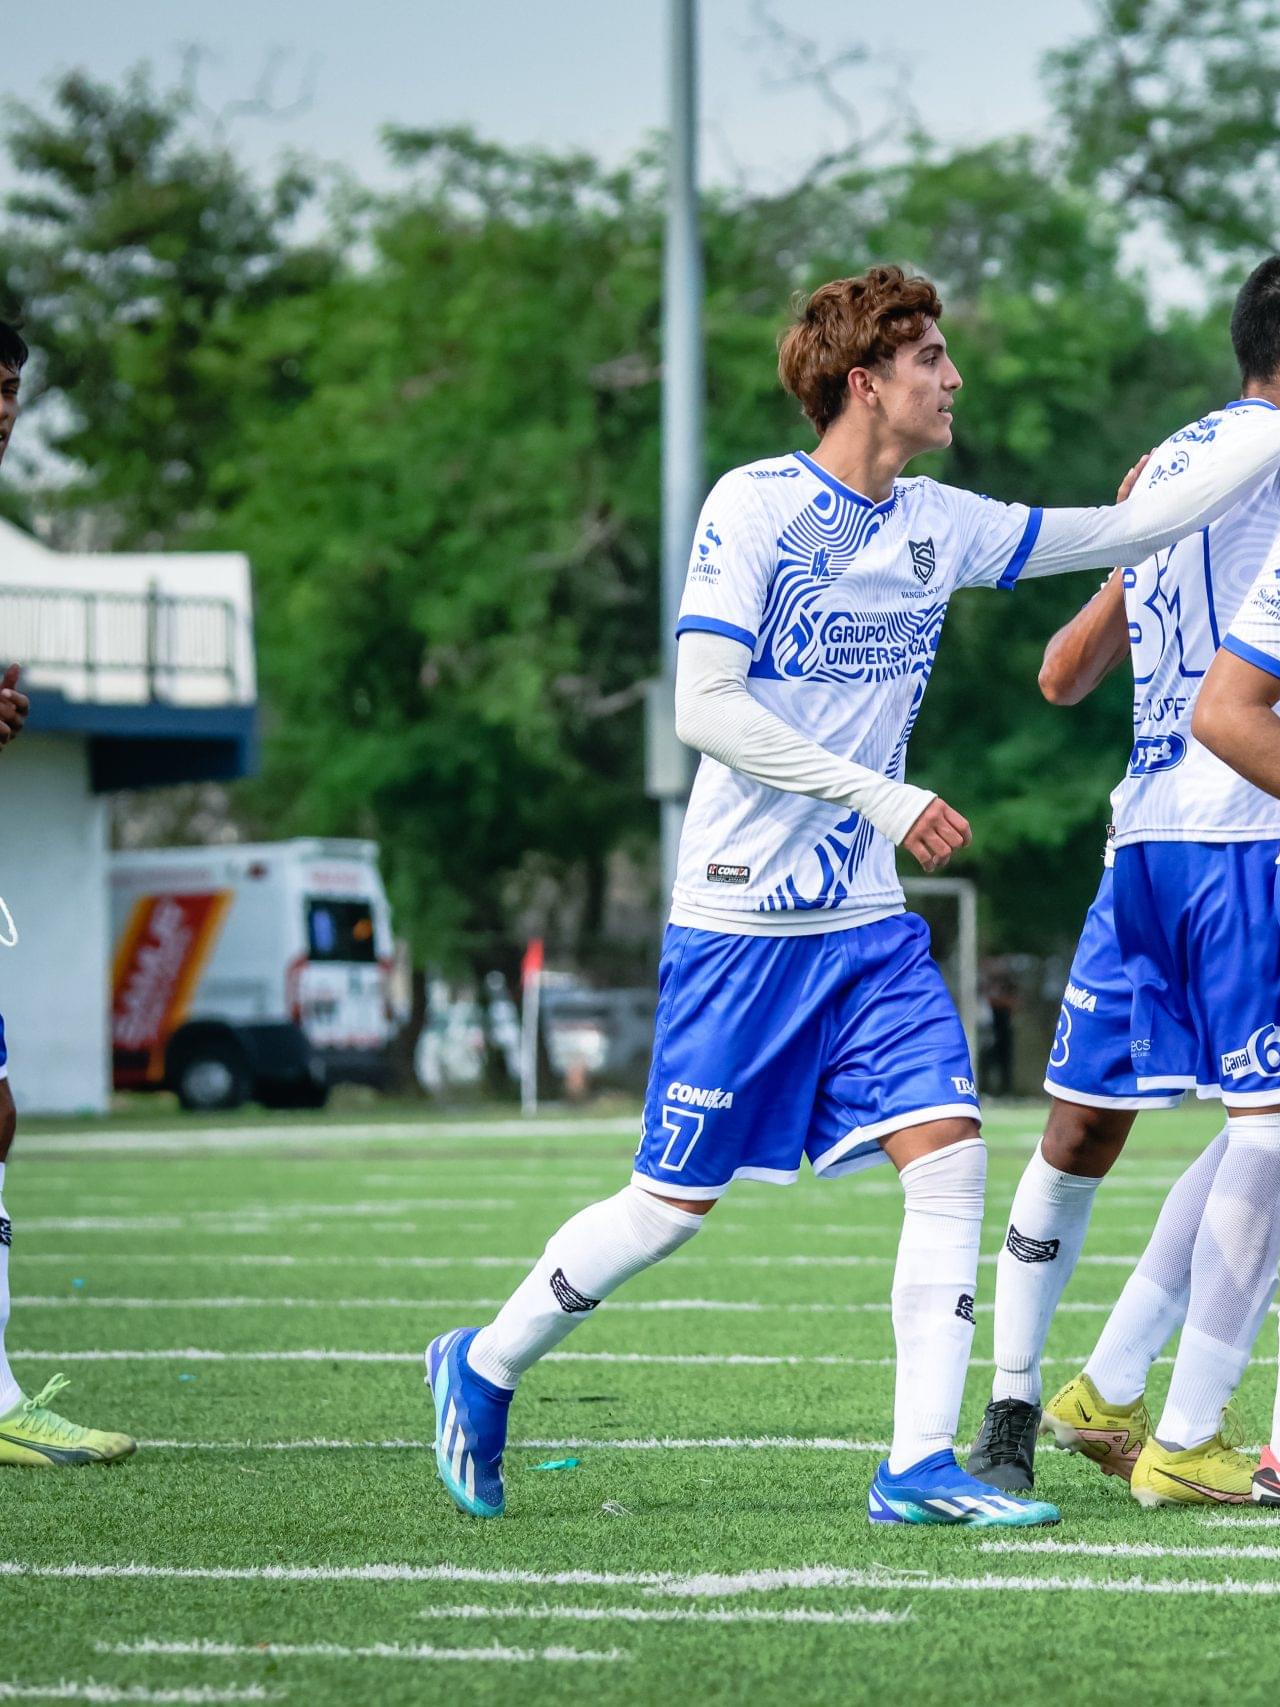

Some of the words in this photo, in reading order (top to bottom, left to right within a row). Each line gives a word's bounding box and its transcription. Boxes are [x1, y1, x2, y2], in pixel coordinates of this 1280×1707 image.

[828, 625, 886, 644] GRUPO
[1224, 1049, 1252, 1073] Canal
[666, 1082, 734, 1111] CONIKA
